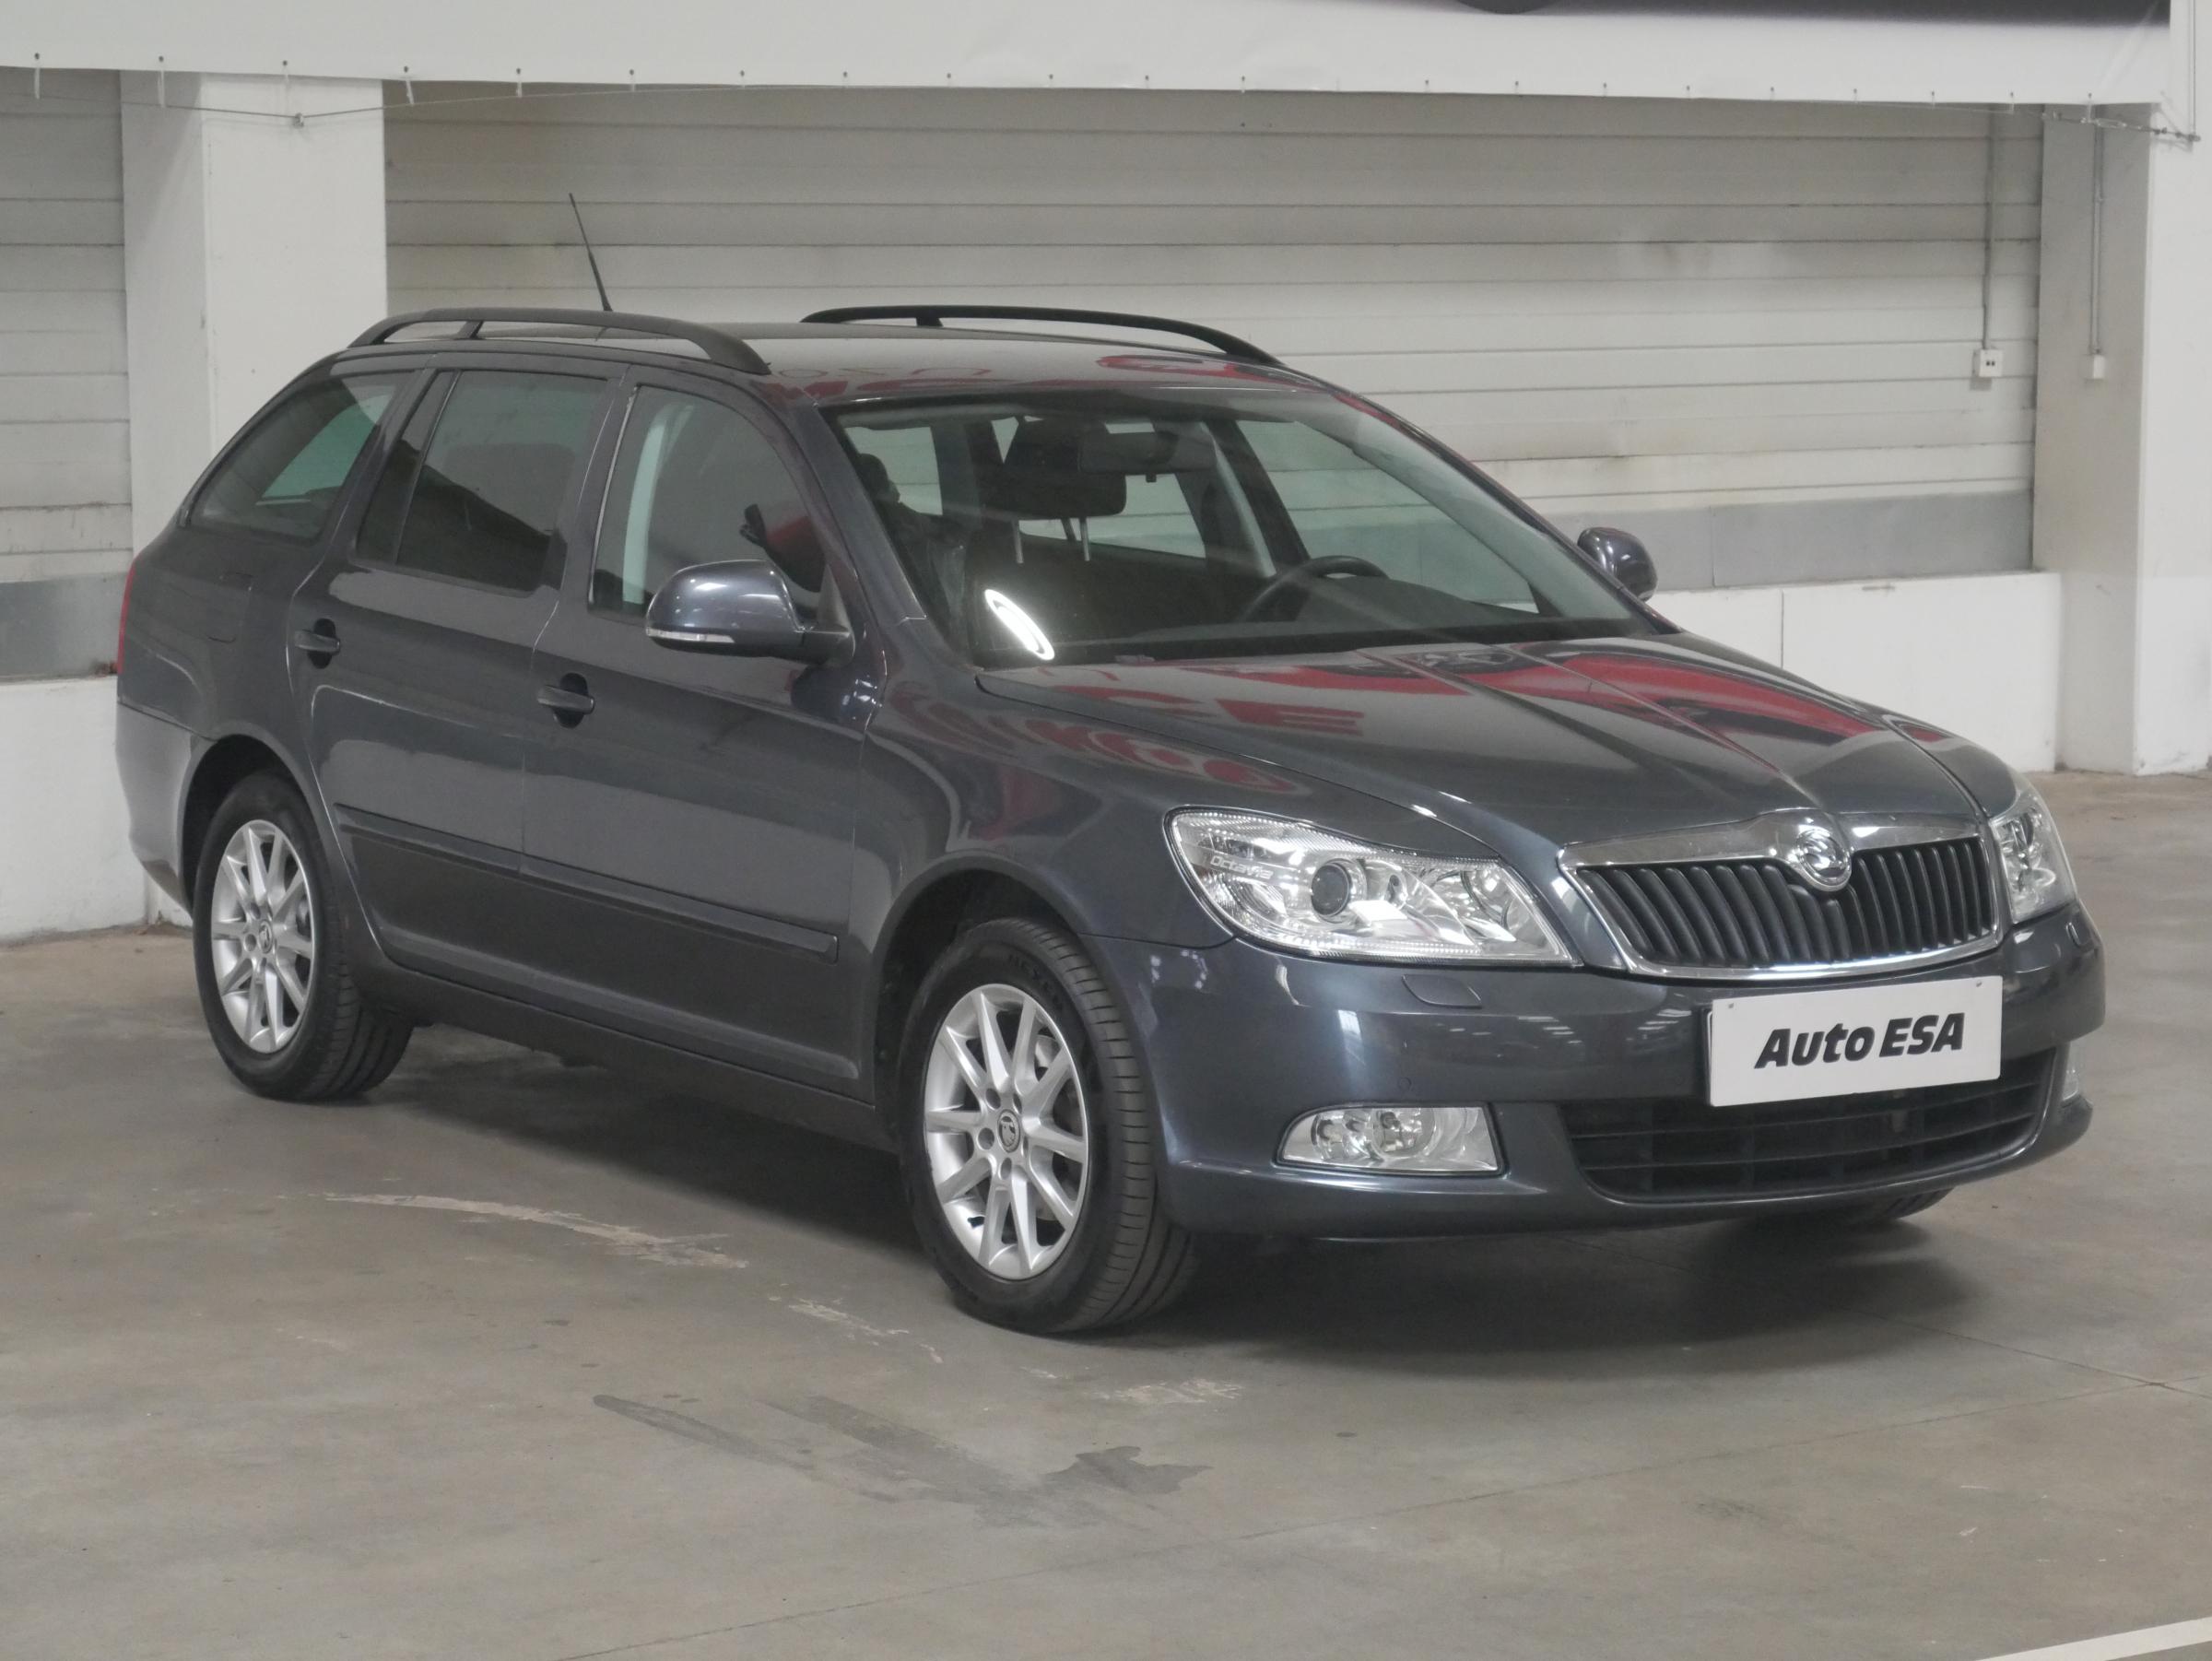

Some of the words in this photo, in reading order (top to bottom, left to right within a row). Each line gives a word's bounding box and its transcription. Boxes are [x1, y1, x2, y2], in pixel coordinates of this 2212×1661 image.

[1210, 854, 1274, 880] Octavia
[1753, 1023, 1876, 1069] Auto
[1878, 1012, 1966, 1058] ESA
